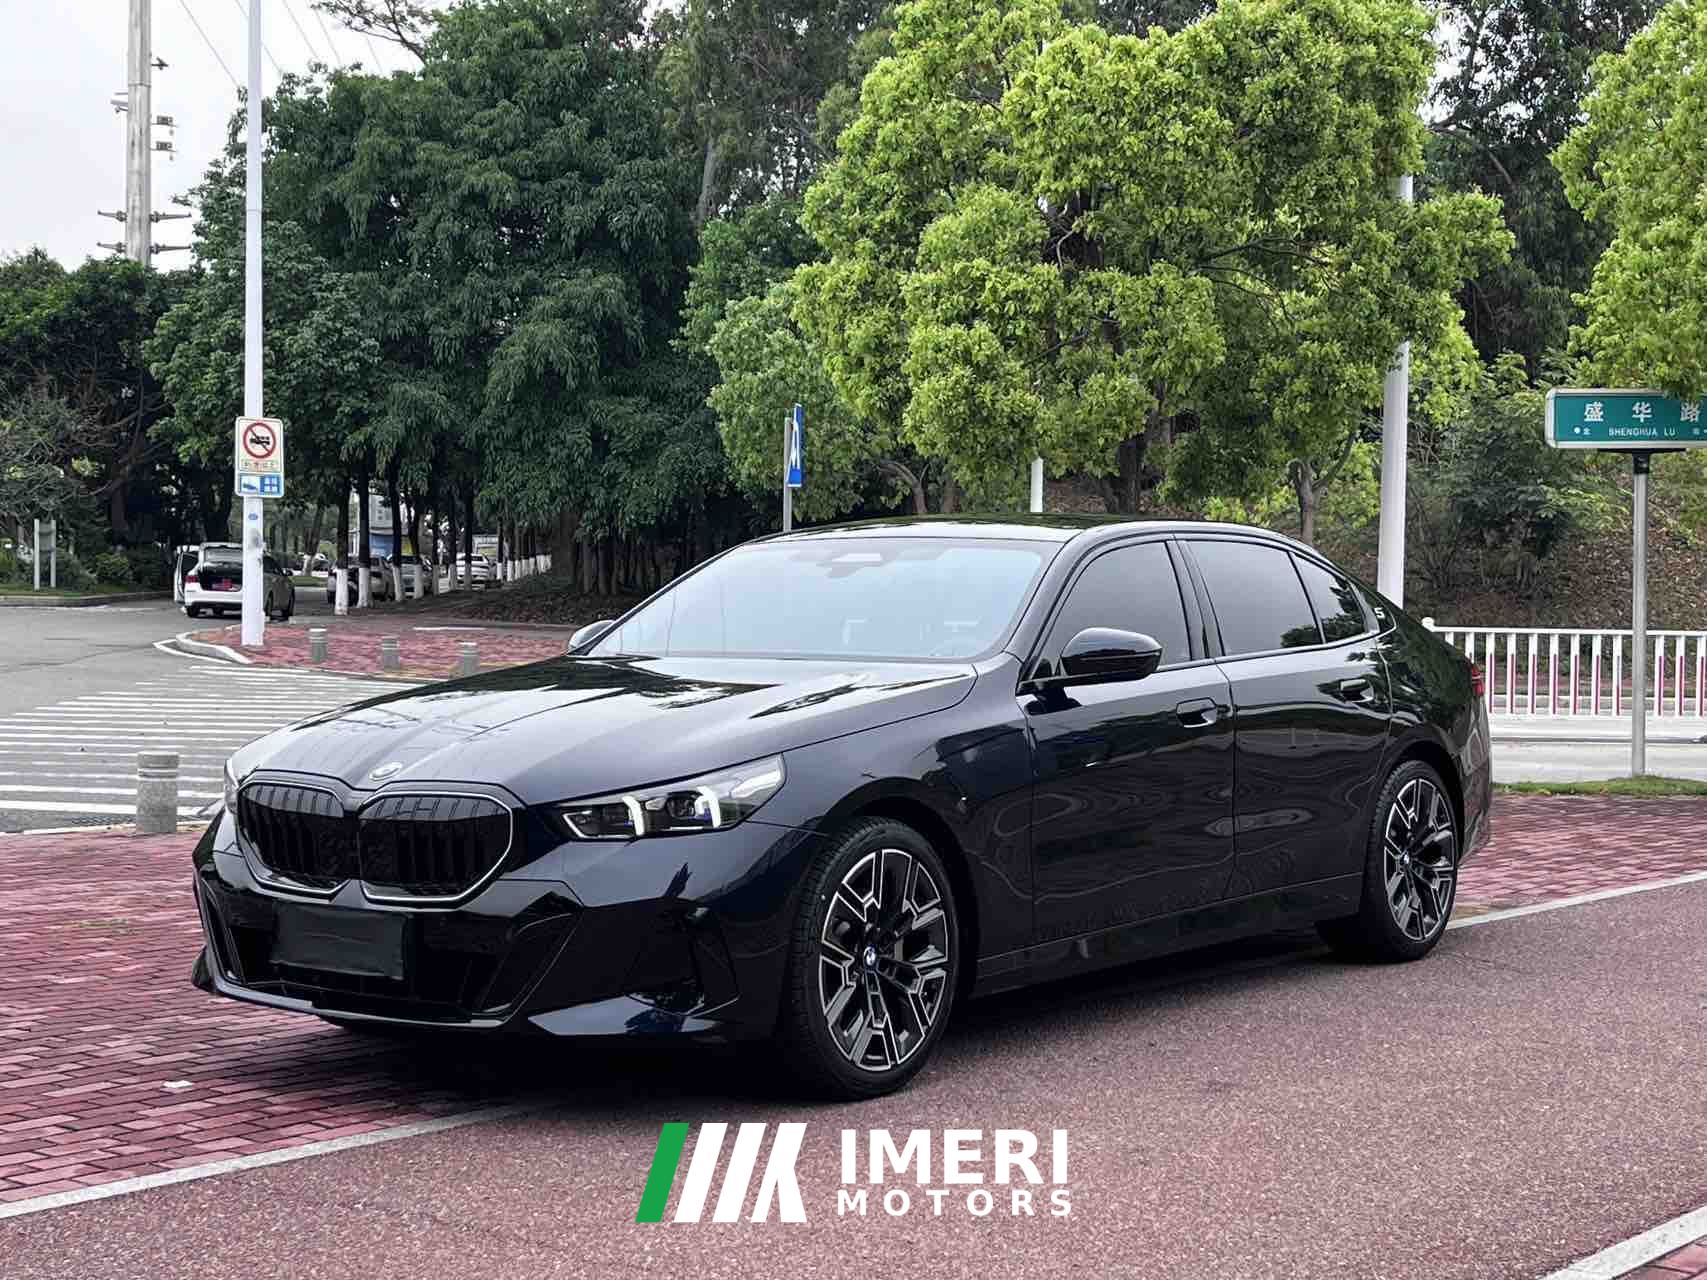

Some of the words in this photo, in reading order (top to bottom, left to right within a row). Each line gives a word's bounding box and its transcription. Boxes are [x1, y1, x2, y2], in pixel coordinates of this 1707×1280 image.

[1584, 401, 1701, 422] 盛华路
[1608, 427, 1658, 437] SHENGHUA
[1664, 427, 1676, 436] LU
[1374, 607, 1385, 618] 5
